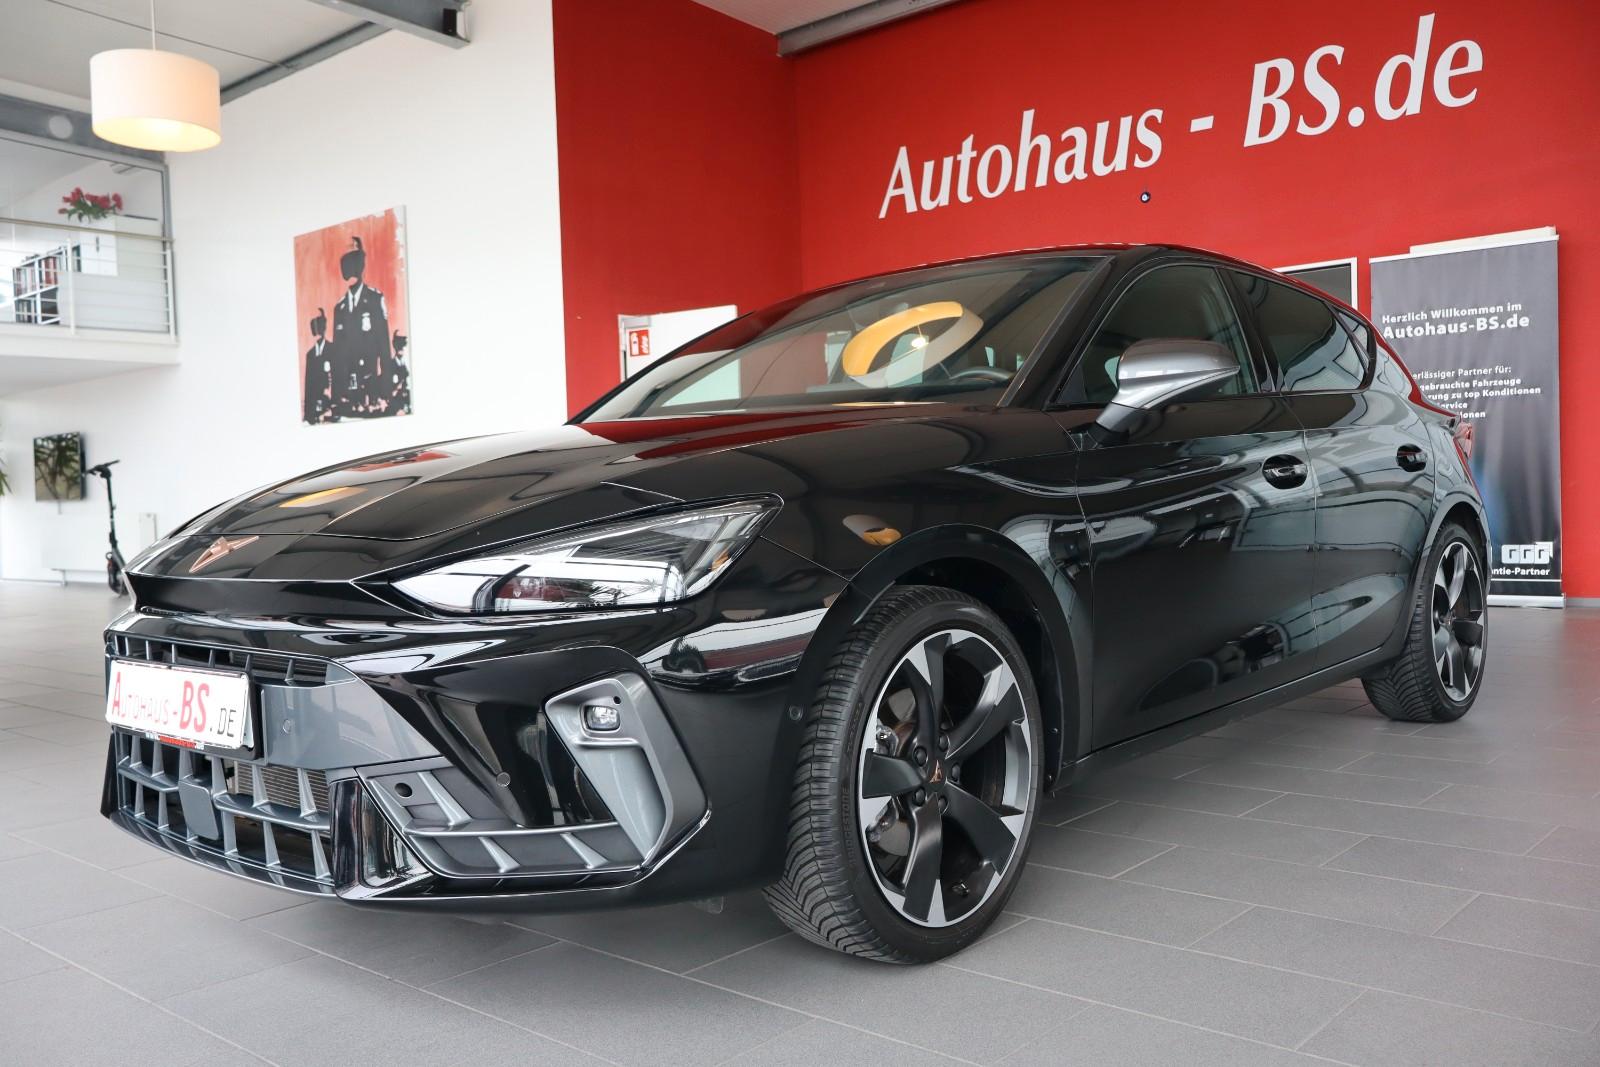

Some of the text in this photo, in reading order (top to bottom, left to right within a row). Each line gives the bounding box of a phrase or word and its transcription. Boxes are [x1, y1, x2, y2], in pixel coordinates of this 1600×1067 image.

[878, 108, 1163, 219] Autohaus
[1243, 13, 1484, 148] BS.de
[1382, 302, 1522, 324] Herzlich Willkommen im
[1383, 313, 1530, 339] Autohaus-BS.de
[1412, 364, 1512, 380] erlässiger Partner für:
[1472, 378, 1522, 388] Fahrzeuge
[1464, 390, 1480, 399] top
[1482, 387, 1541, 397] Konditionen
